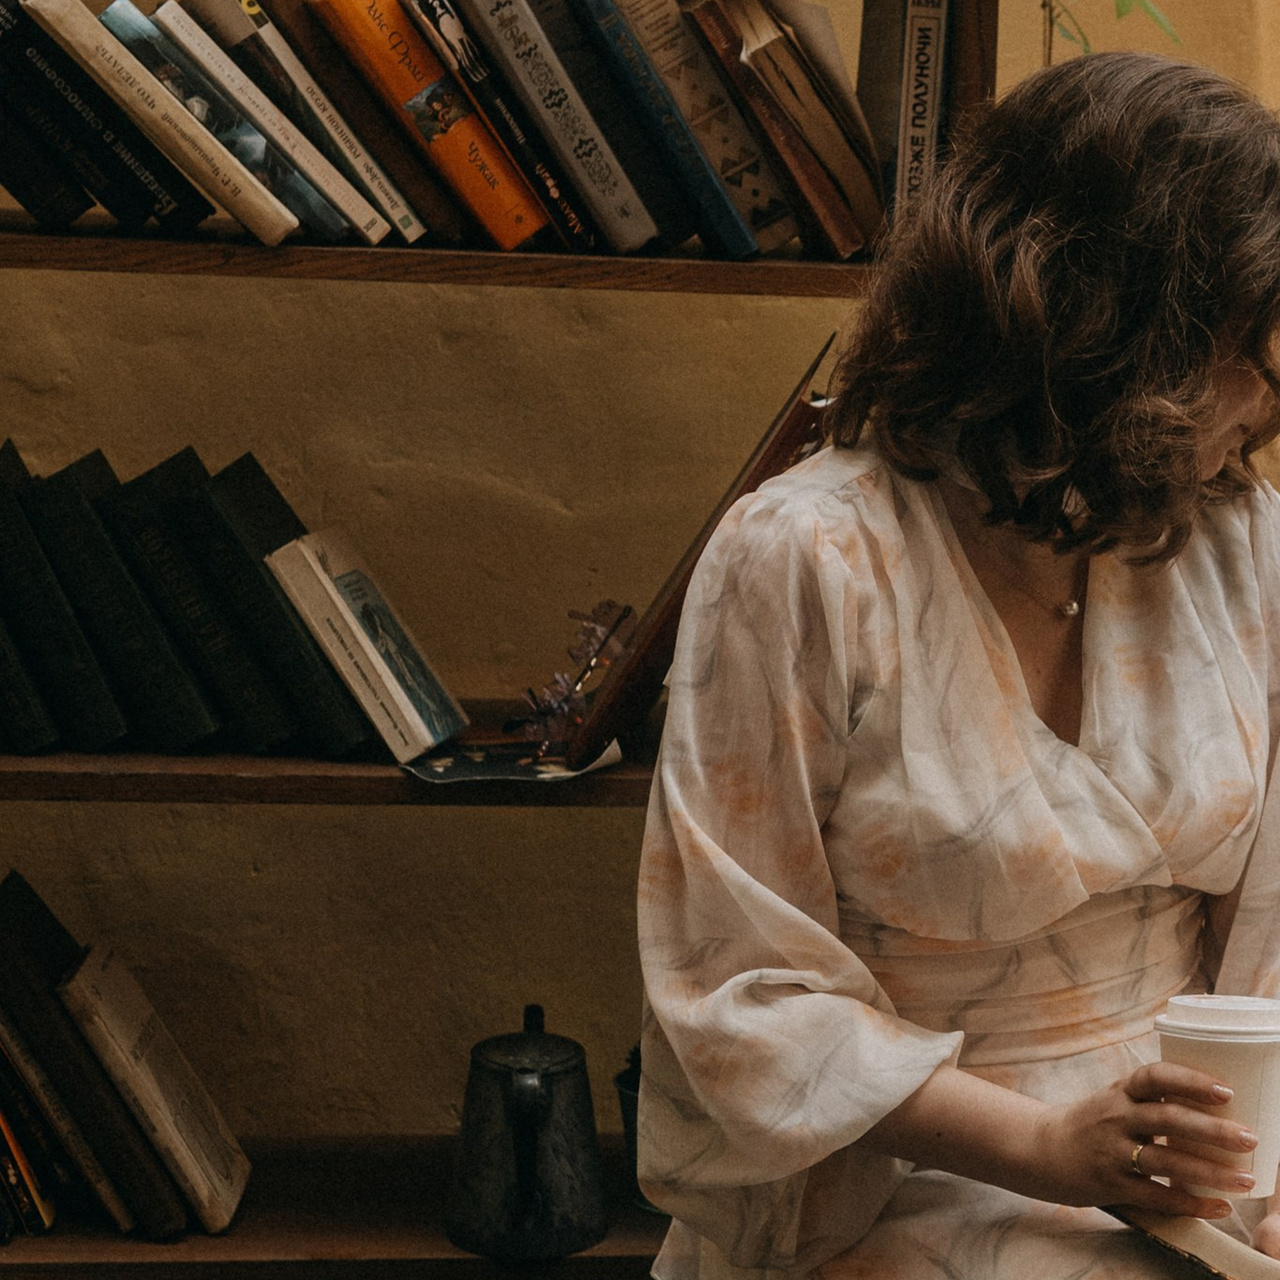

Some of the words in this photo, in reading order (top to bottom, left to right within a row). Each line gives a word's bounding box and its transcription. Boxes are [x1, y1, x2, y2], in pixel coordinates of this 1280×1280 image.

[95, 44, 137, 89] ДЕЛАТЬ?
[387, 32, 424, 83] Фрай
[911, 26, 932, 128] ПОЛУНОЧИ
[137, 86, 157, 110] ЧТО
[305, 86, 328, 114] КРУЗО
[162, 112, 221, 173] Чернышевский
[326, 115, 361, 158] РОБИНЗОН
[217, 172, 232, 187] Г.
[467, 142, 499, 189] Чужак
[535, 161, 560, 199] Фрай
[557, 200, 583, 235] Макс
